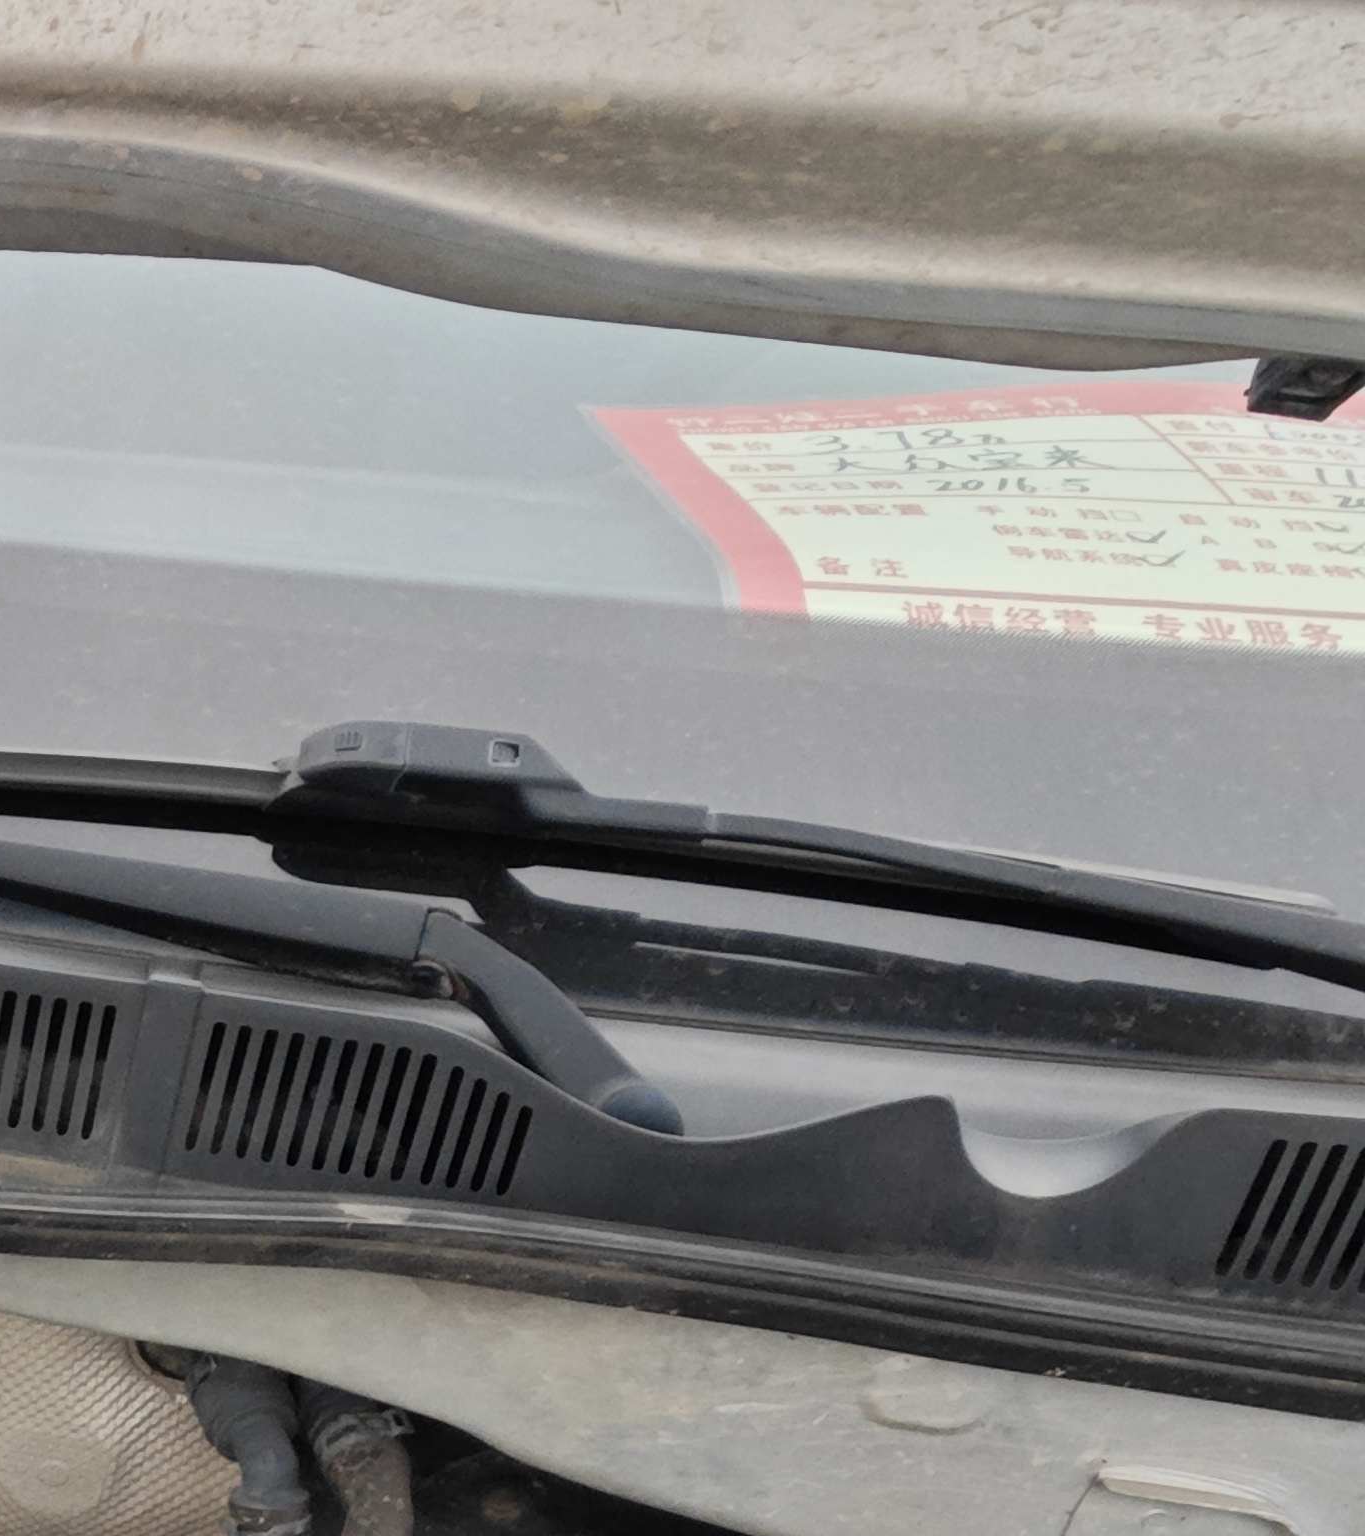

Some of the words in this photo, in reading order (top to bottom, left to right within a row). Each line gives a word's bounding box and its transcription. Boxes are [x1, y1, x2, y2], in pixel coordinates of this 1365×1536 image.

[902, 601, 1098, 637] 诚信经营
[1141, 613, 1344, 651] 专业服务
